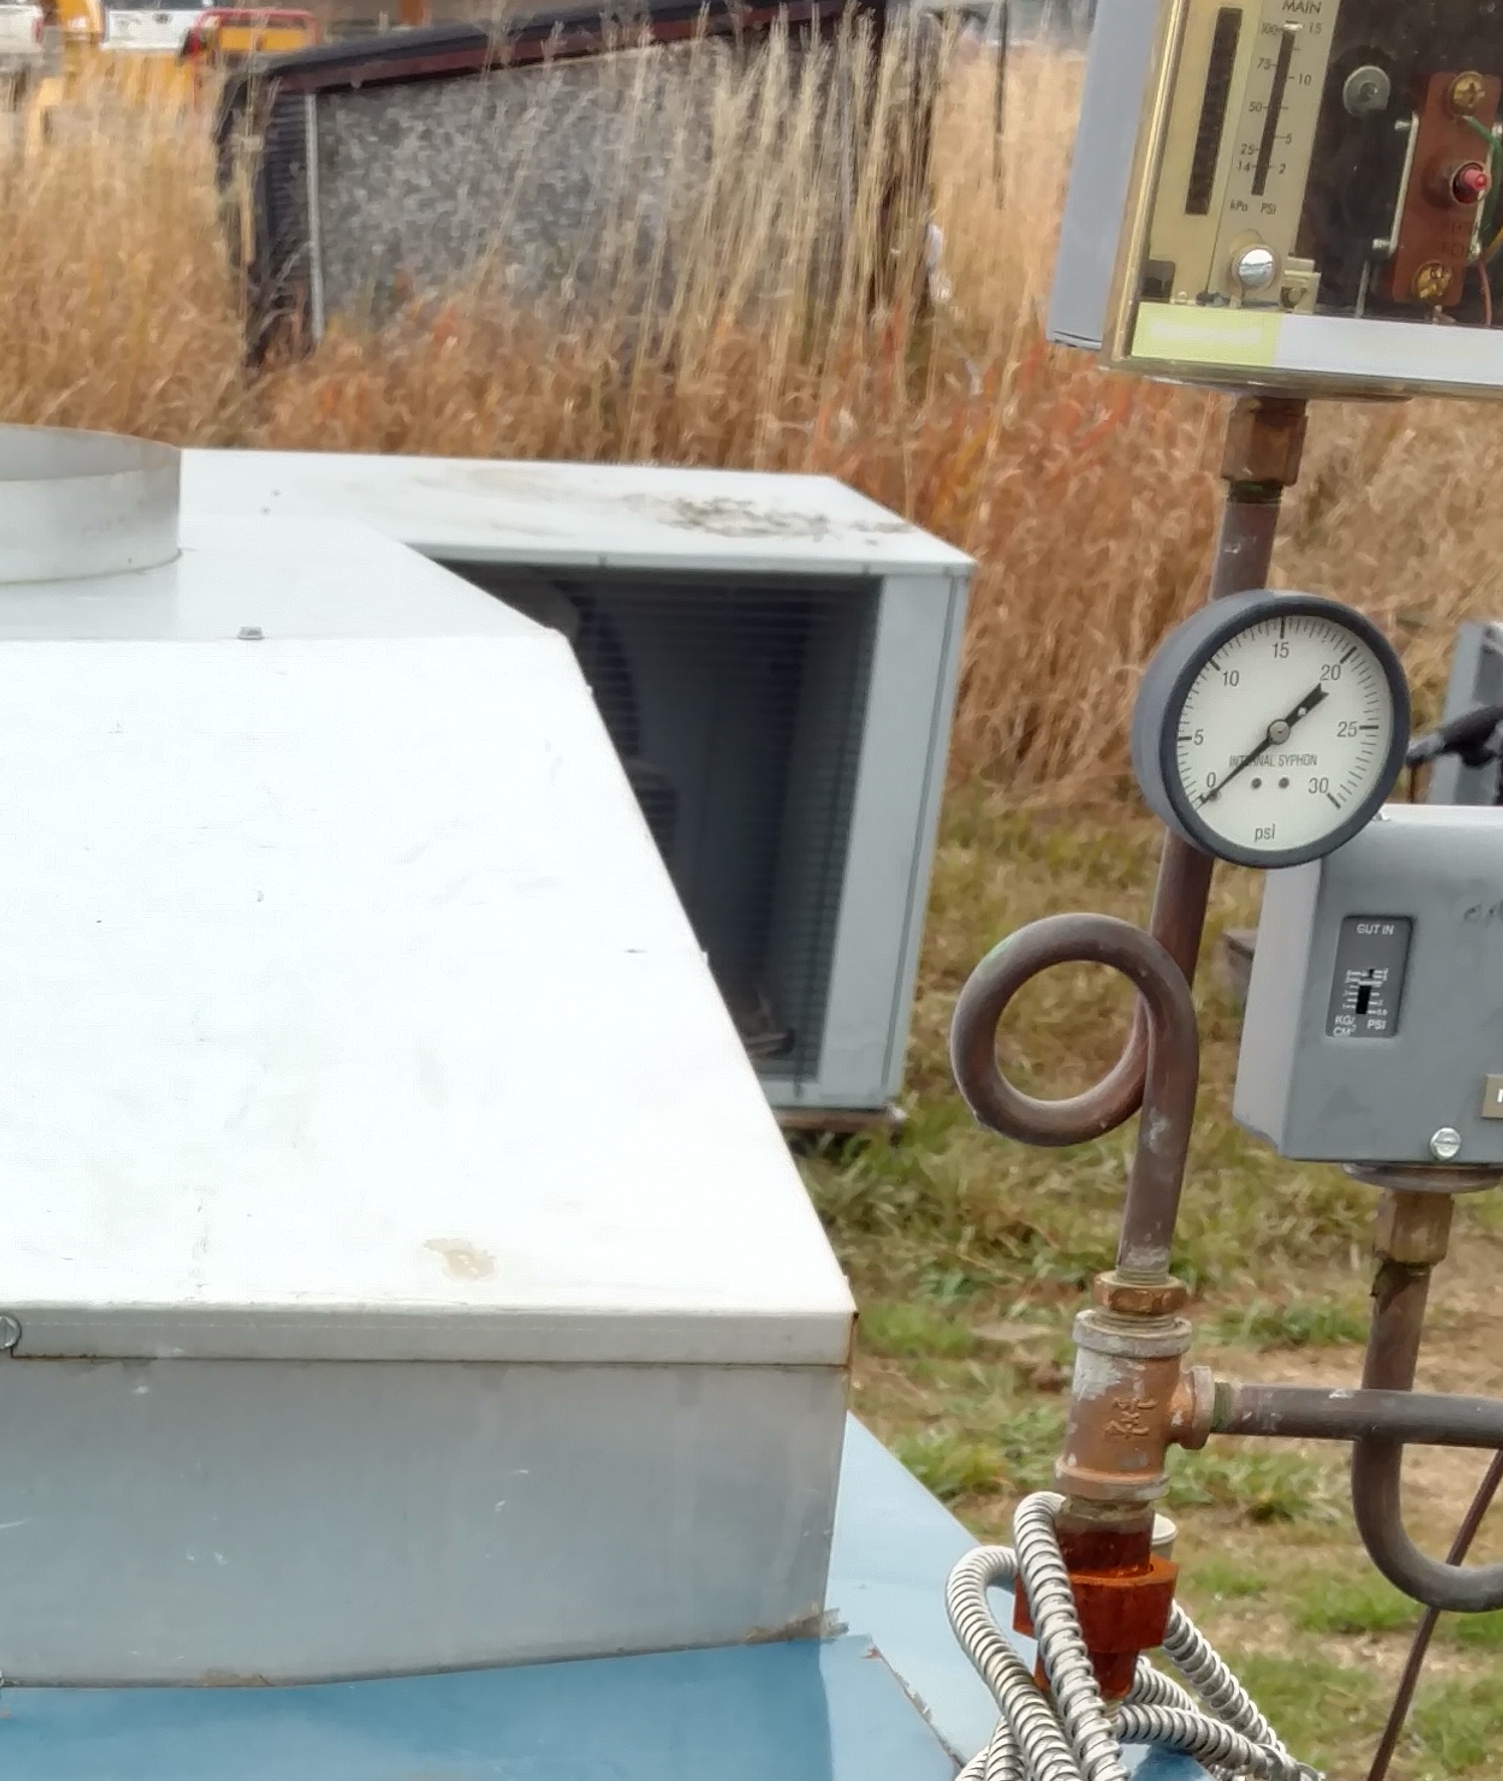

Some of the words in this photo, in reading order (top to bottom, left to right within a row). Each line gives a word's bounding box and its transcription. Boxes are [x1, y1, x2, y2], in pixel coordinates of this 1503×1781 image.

[1282, 0, 1322, 14] MAIN
[1309, 23, 1322, 34] 15
[1257, 58, 1271, 70] 75
[1299, 74, 1312, 86] 10
[1249, 102, 1262, 112] 50
[1241, 144, 1255, 155] 25
[1279, 163, 1286, 174] 2
[1273, 642, 1290, 659] 15
[1223, 670, 1240, 687] 10
[1320, 664, 1341, 681] 20
[1337, 721, 1358, 738] 25
[1193, 729, 1204, 745] 5
[1278, 754, 1317, 767] SYPHON
[1206, 772, 1216, 788] 0
[1308, 777, 1329, 794] 30
[1254, 823, 1276, 842] psi
[1382, 924, 1395, 935] IN
[1367, 1018, 1387, 1030] PSI
